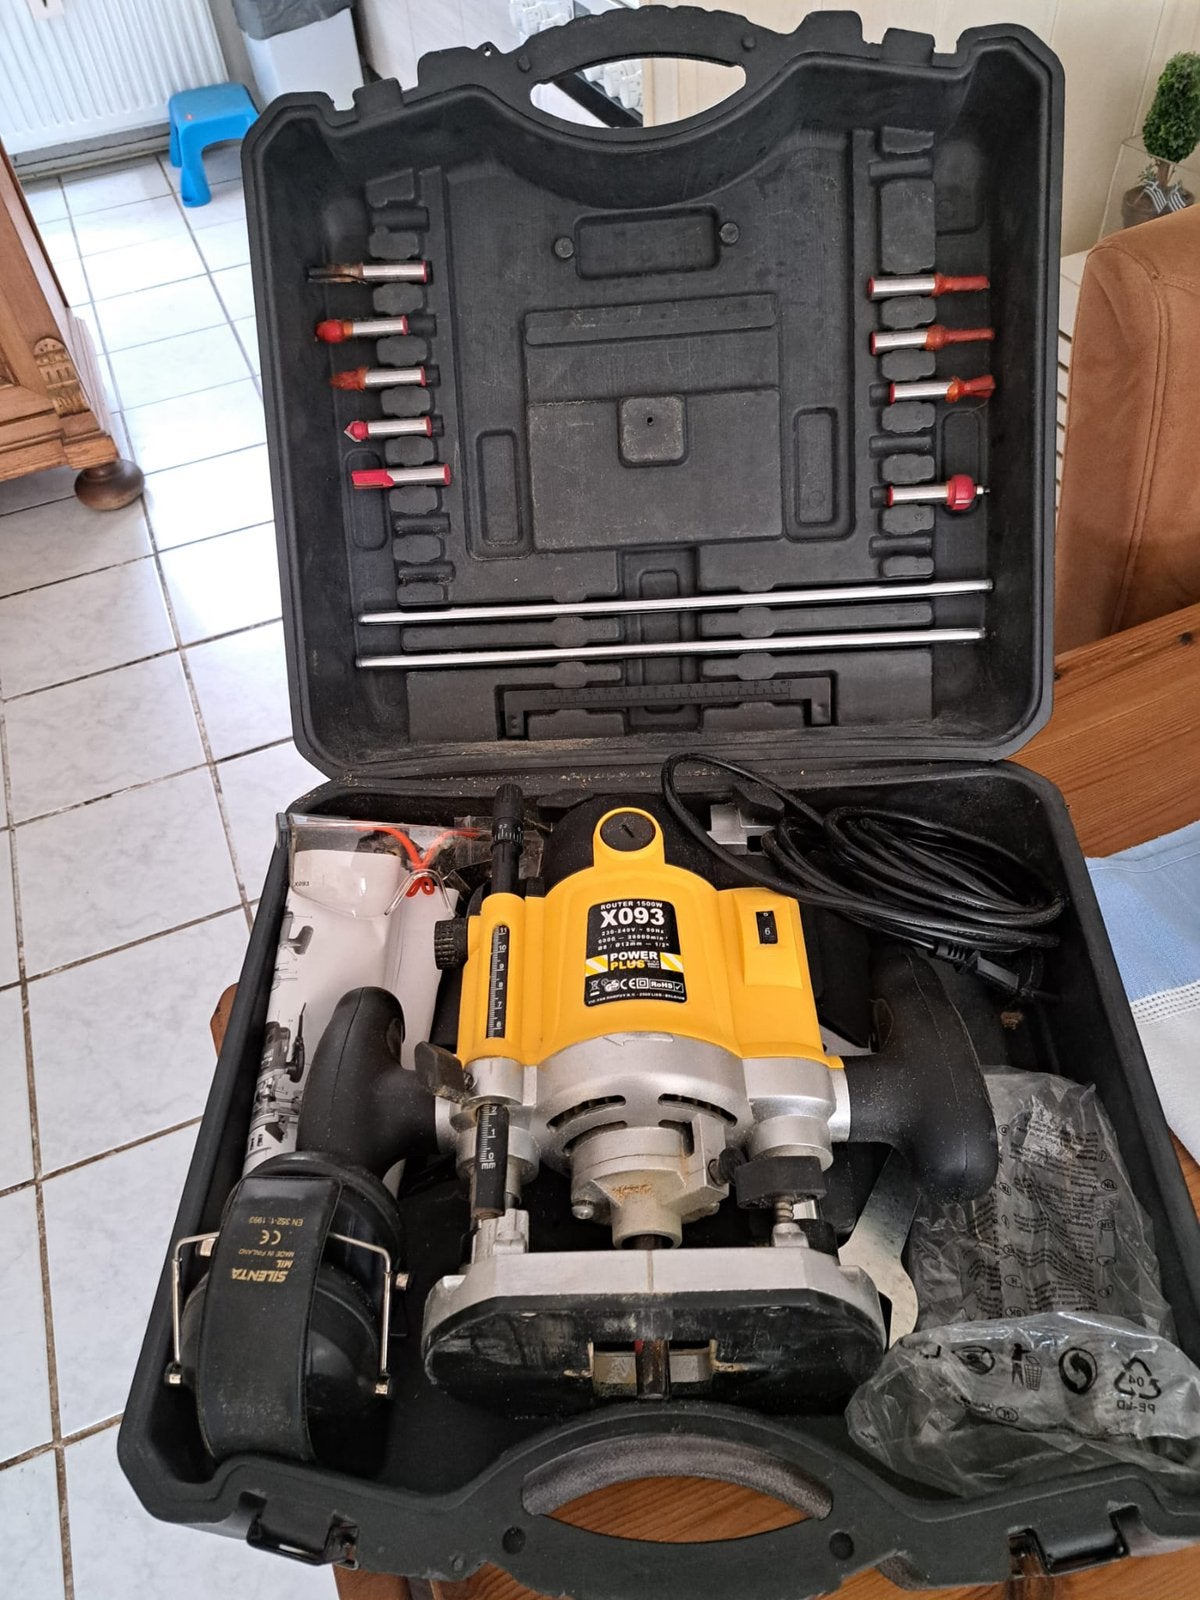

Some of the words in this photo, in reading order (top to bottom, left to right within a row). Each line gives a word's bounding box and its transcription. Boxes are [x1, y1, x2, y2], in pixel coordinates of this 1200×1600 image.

[601, 901, 633, 910] ROUTER
[600, 907, 665, 928] X093
[764, 927, 771, 936] 6
[610, 951, 658, 961] POWER
[610, 960, 645, 971] PLUS
[651, 980, 673, 989] RoHS
[481, 1162, 496, 1170] mm
[291, 1218, 304, 1226] EN
[259, 1230, 281, 1245] CE
[276, 1260, 294, 1269] MIL
[231, 1267, 289, 1283] SILENTA
